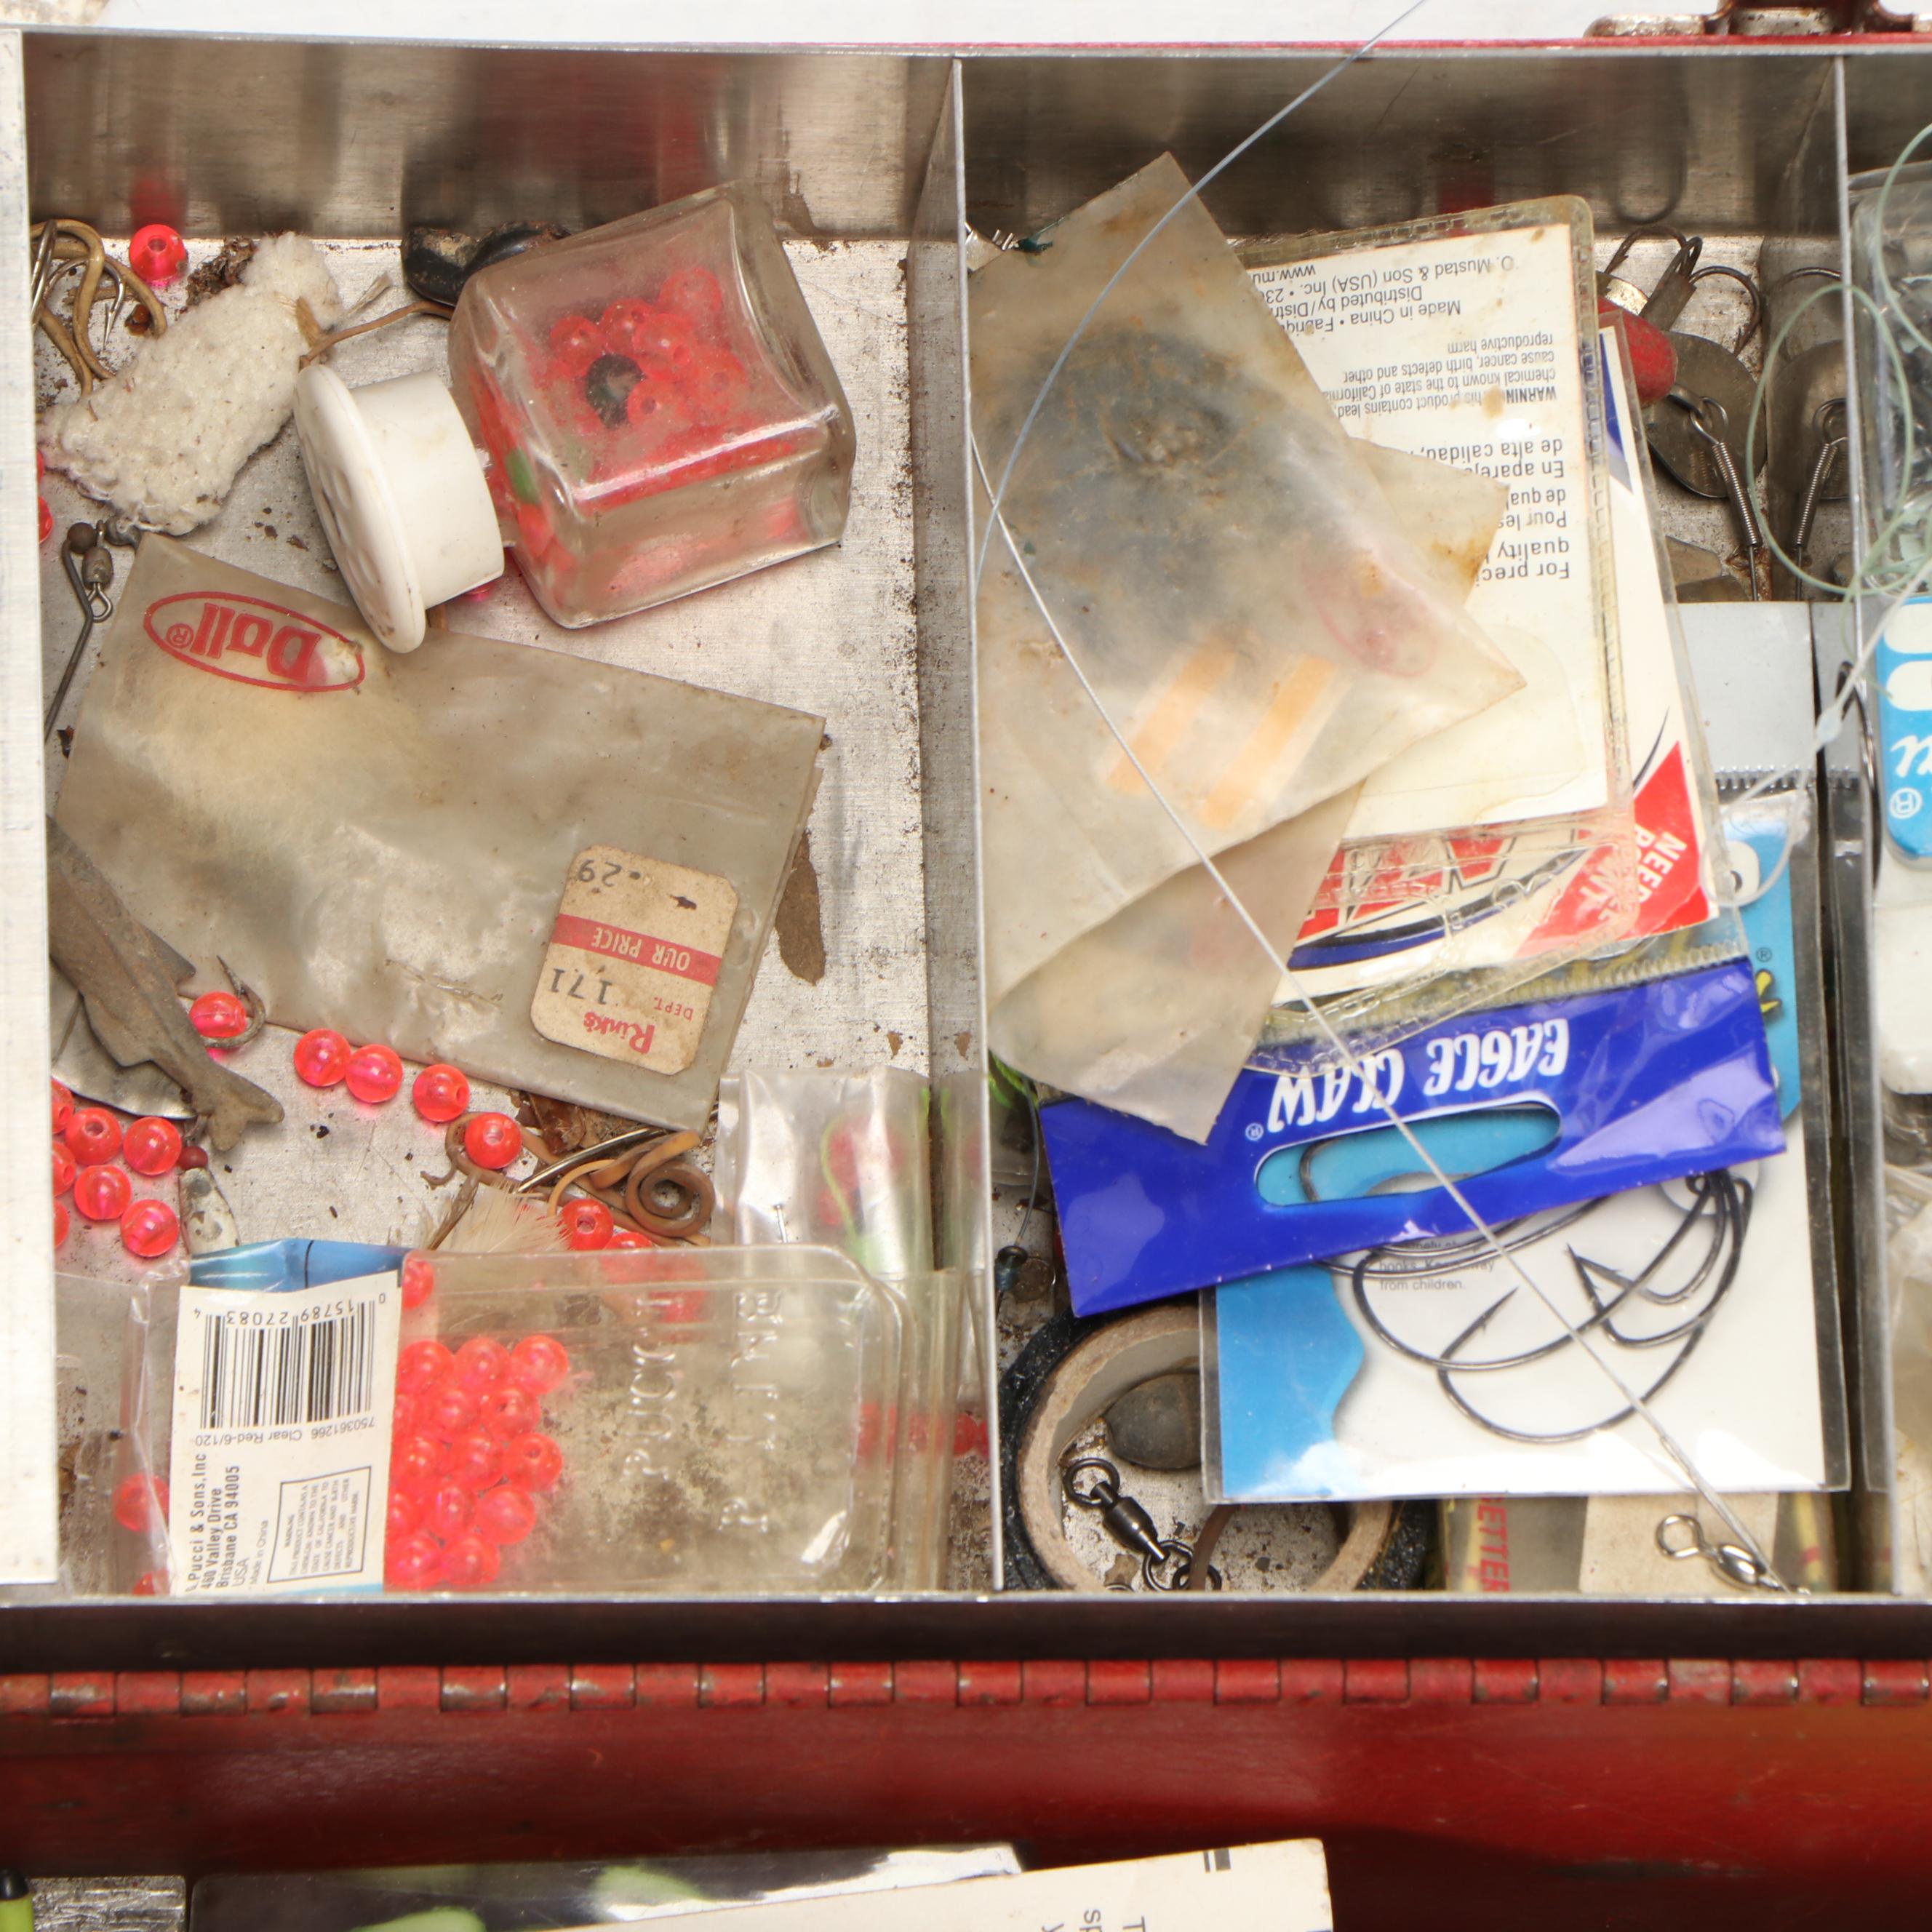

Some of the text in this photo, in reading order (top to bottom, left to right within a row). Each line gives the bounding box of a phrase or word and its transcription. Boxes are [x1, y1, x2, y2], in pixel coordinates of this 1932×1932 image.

[1434, 258, 1490, 279] Mustad
[1496, 255, 1514, 271] O.
[1332, 270, 1378, 293] (USA)
[1383, 268, 1413, 284] Son
[1418, 267, 1429, 282] &
[1300, 282, 1326, 296] Inc.
[1341, 285, 1422, 310] Distributed
[1350, 309, 1394, 324] China
[1400, 306, 1413, 319] in
[1418, 300, 1461, 316] Made
[1448, 331, 1552, 356] reproductive harm
[1344, 350, 1554, 385] cause cancer, birth defects and other
[1504, 367, 1555, 385] chemical
[1379, 383, 1391, 397] of
[1394, 380, 1422, 396] state
[1426, 377, 1443, 393] the
[1448, 376, 1458, 391] to
[1463, 372, 1500, 391] known
[1464, 390, 1482, 407] his
[1496, 386, 1557, 404] WARNIN
[1365, 397, 1412, 416] contains
[1501, 442, 1533, 459] alta
[1541, 439, 1562, 455] de
[1542, 460, 1564, 478] En
[1546, 489, 1565, 505] de
[1526, 511, 1566, 527] Pour
[1498, 537, 1569, 562] quality
[1536, 562, 1569, 579] For
[590, 927, 691, 972] OUR PRICE
[653, 997, 693, 1021] DEPT.
[1423, 1018, 1569, 1097] EAGLE
[1380, 1279, 1466, 1290] from children.
[193, 1293, 386, 1325] 0 15789 27083 4
[195, 1416, 375, 1447] 750361266 Clear Red-6/120
[207, 1488, 222, 1522] Drive
[189, 1524, 204, 1533] &
[215, 1466, 240, 1589] Brisbane CA 94005
[204, 1528, 224, 1567] Valley
[250, 1520, 269, 1585] Made in China
[1477, 1497, 1512, 1593] ETTER
[231, 1557, 250, 1586] USA
